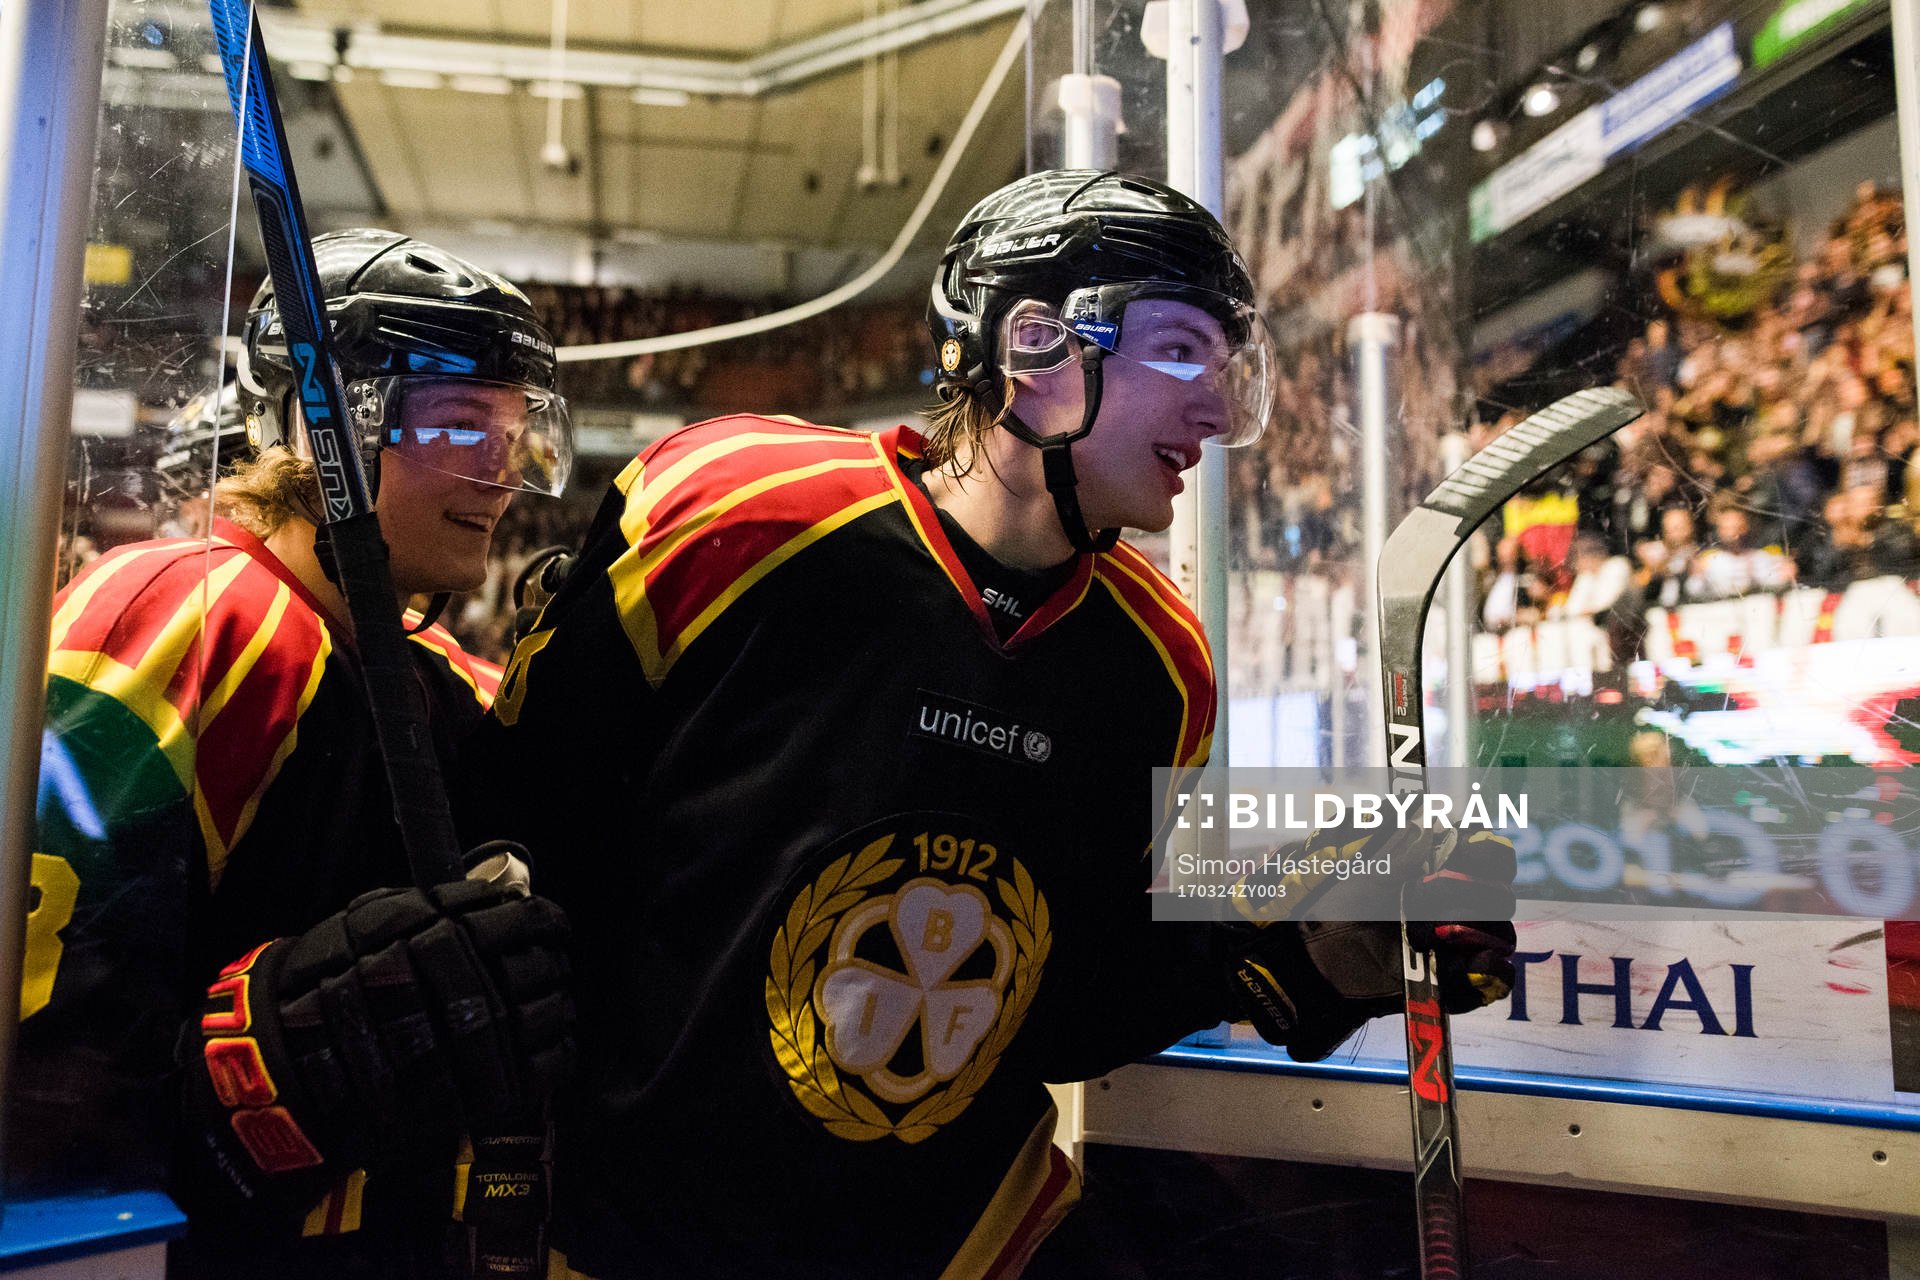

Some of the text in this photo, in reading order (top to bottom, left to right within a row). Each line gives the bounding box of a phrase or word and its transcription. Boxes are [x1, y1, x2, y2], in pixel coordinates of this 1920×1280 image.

[981, 233, 1061, 257] BAUER
[511, 331, 554, 358] BAUER
[1075, 323, 1114, 334] BAUER
[981, 587, 1022, 618] SHL
[919, 706, 1020, 754] unicef
[913, 831, 997, 882] 1912
[922, 908, 955, 953] B
[1238, 968, 1290, 1031] BAUER
[1507, 949, 1759, 1039] THAI
[943, 1004, 974, 1045] F
[484, 1183, 531, 1198] MX3
